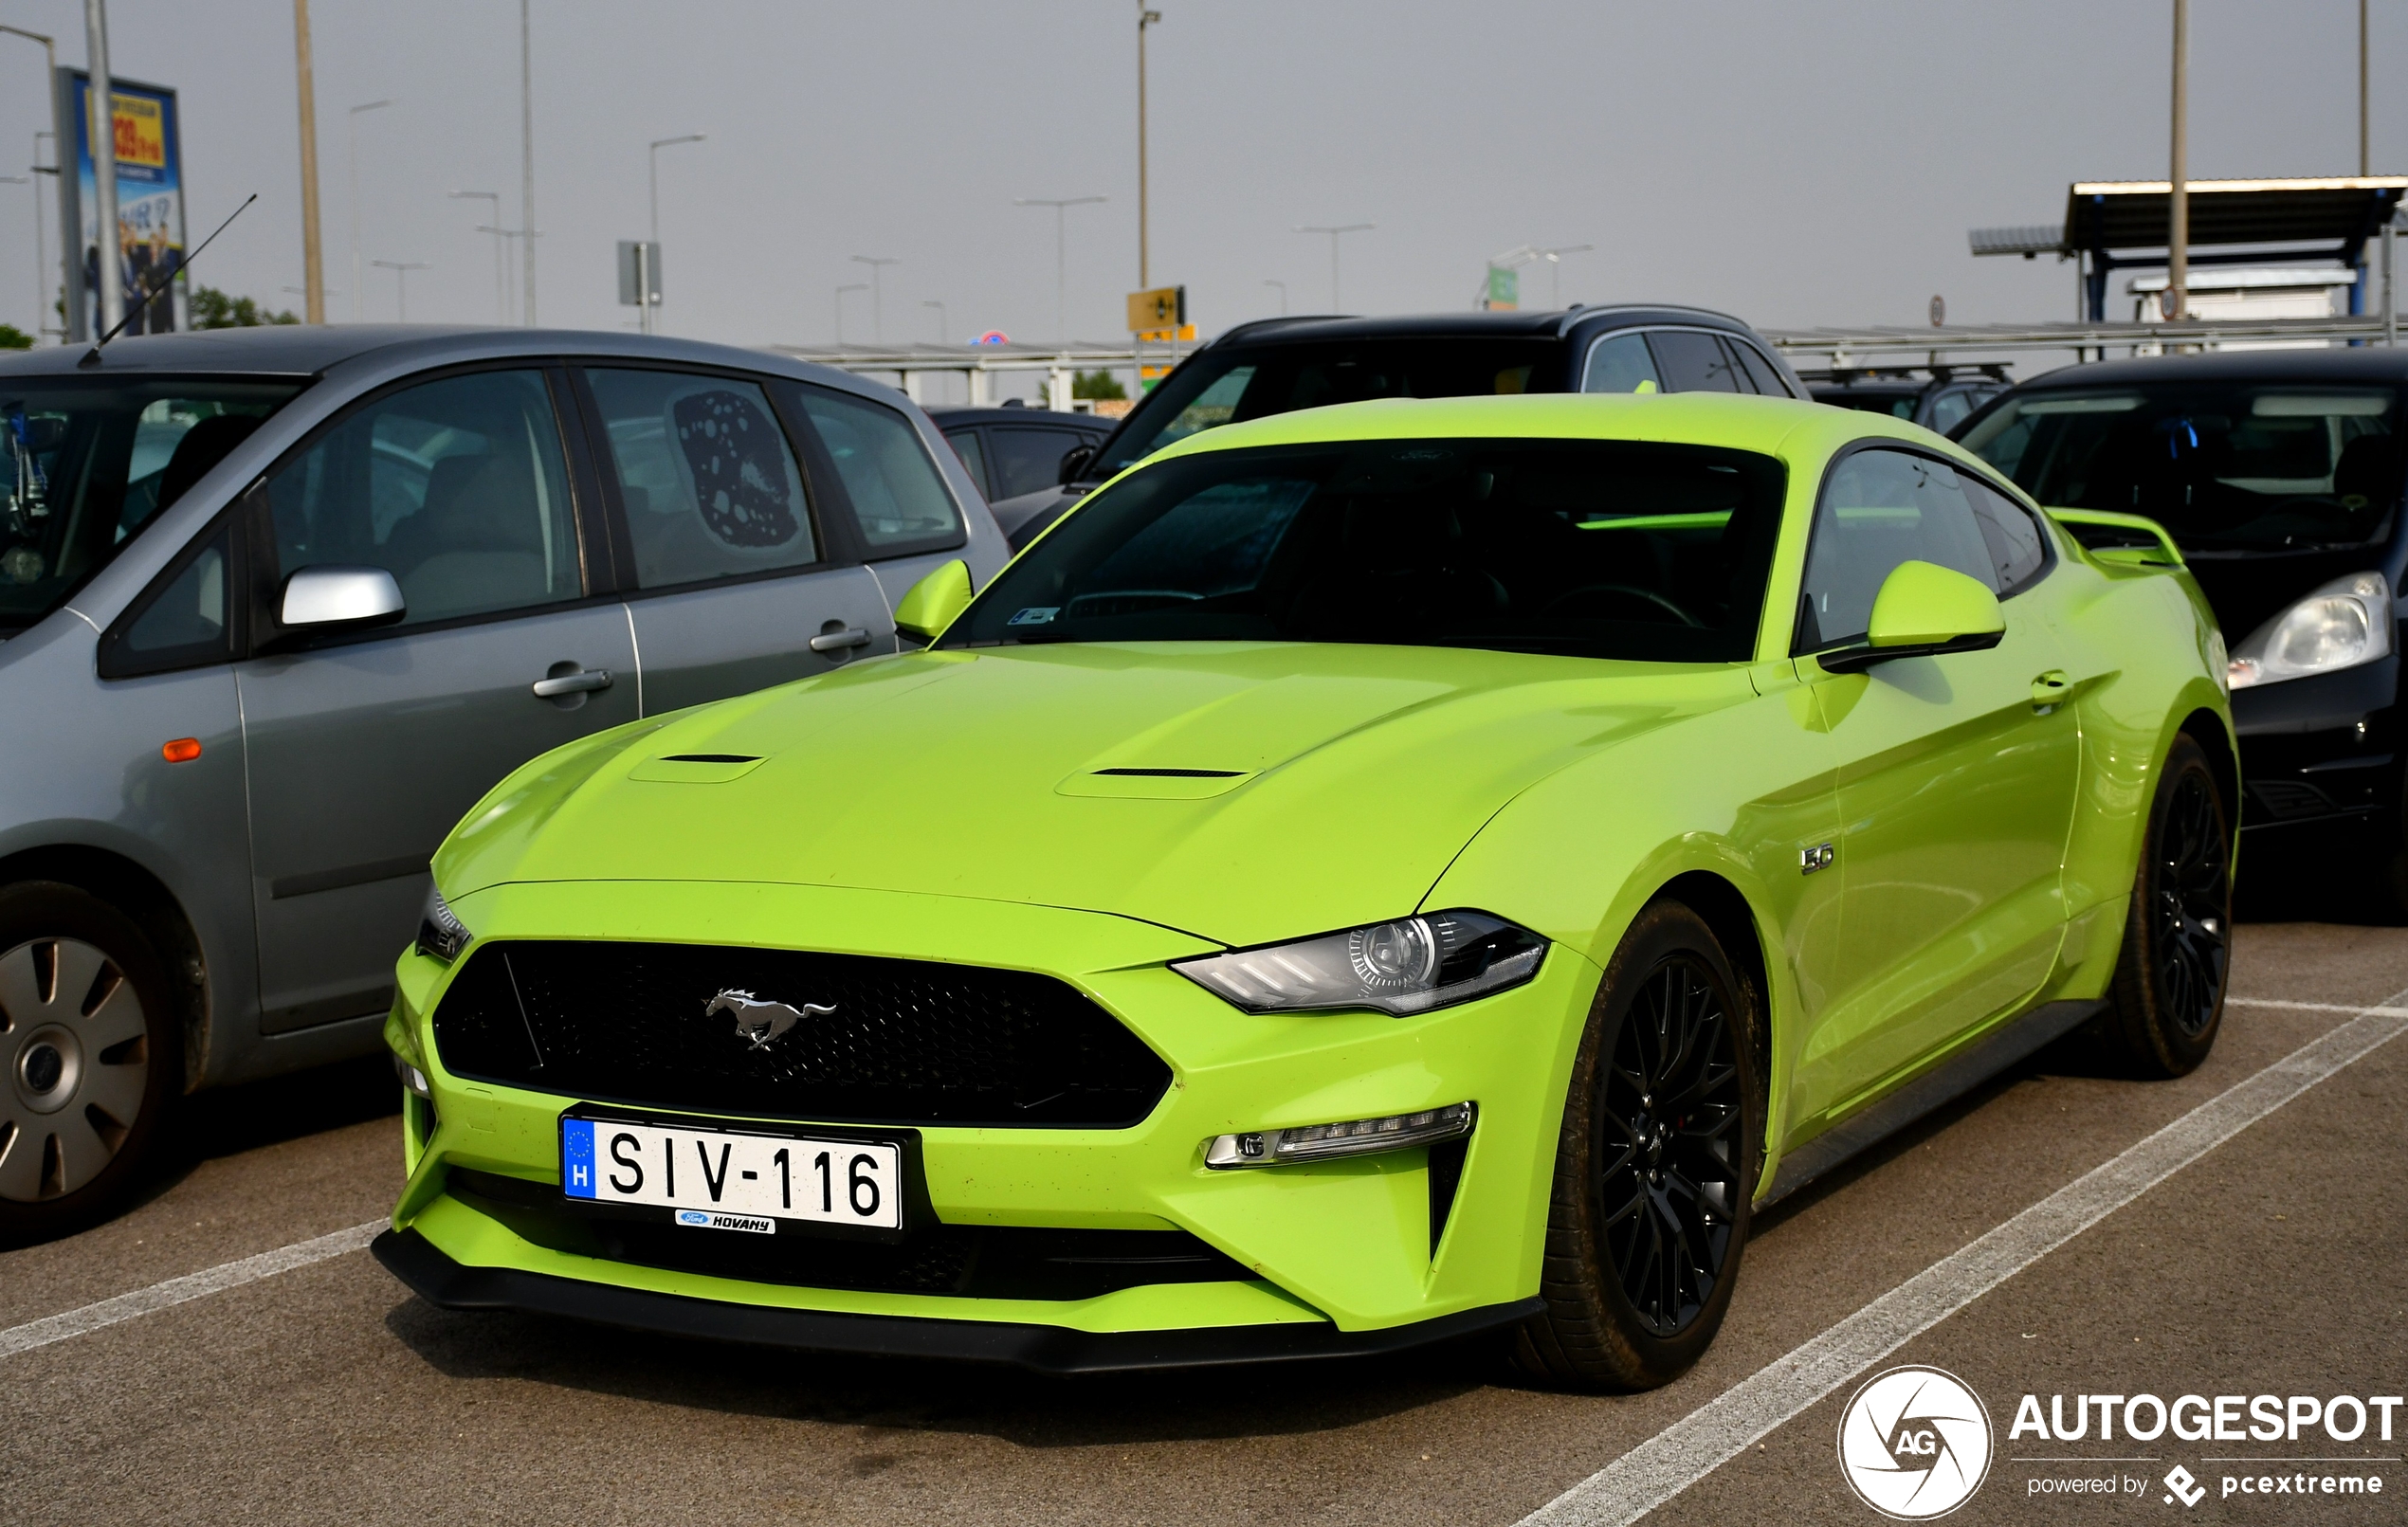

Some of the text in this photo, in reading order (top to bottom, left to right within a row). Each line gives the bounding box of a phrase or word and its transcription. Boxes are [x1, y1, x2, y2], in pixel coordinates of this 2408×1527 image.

[573, 1132, 881, 1217] H SIV-116
[684, 1212, 706, 1224] Ford
